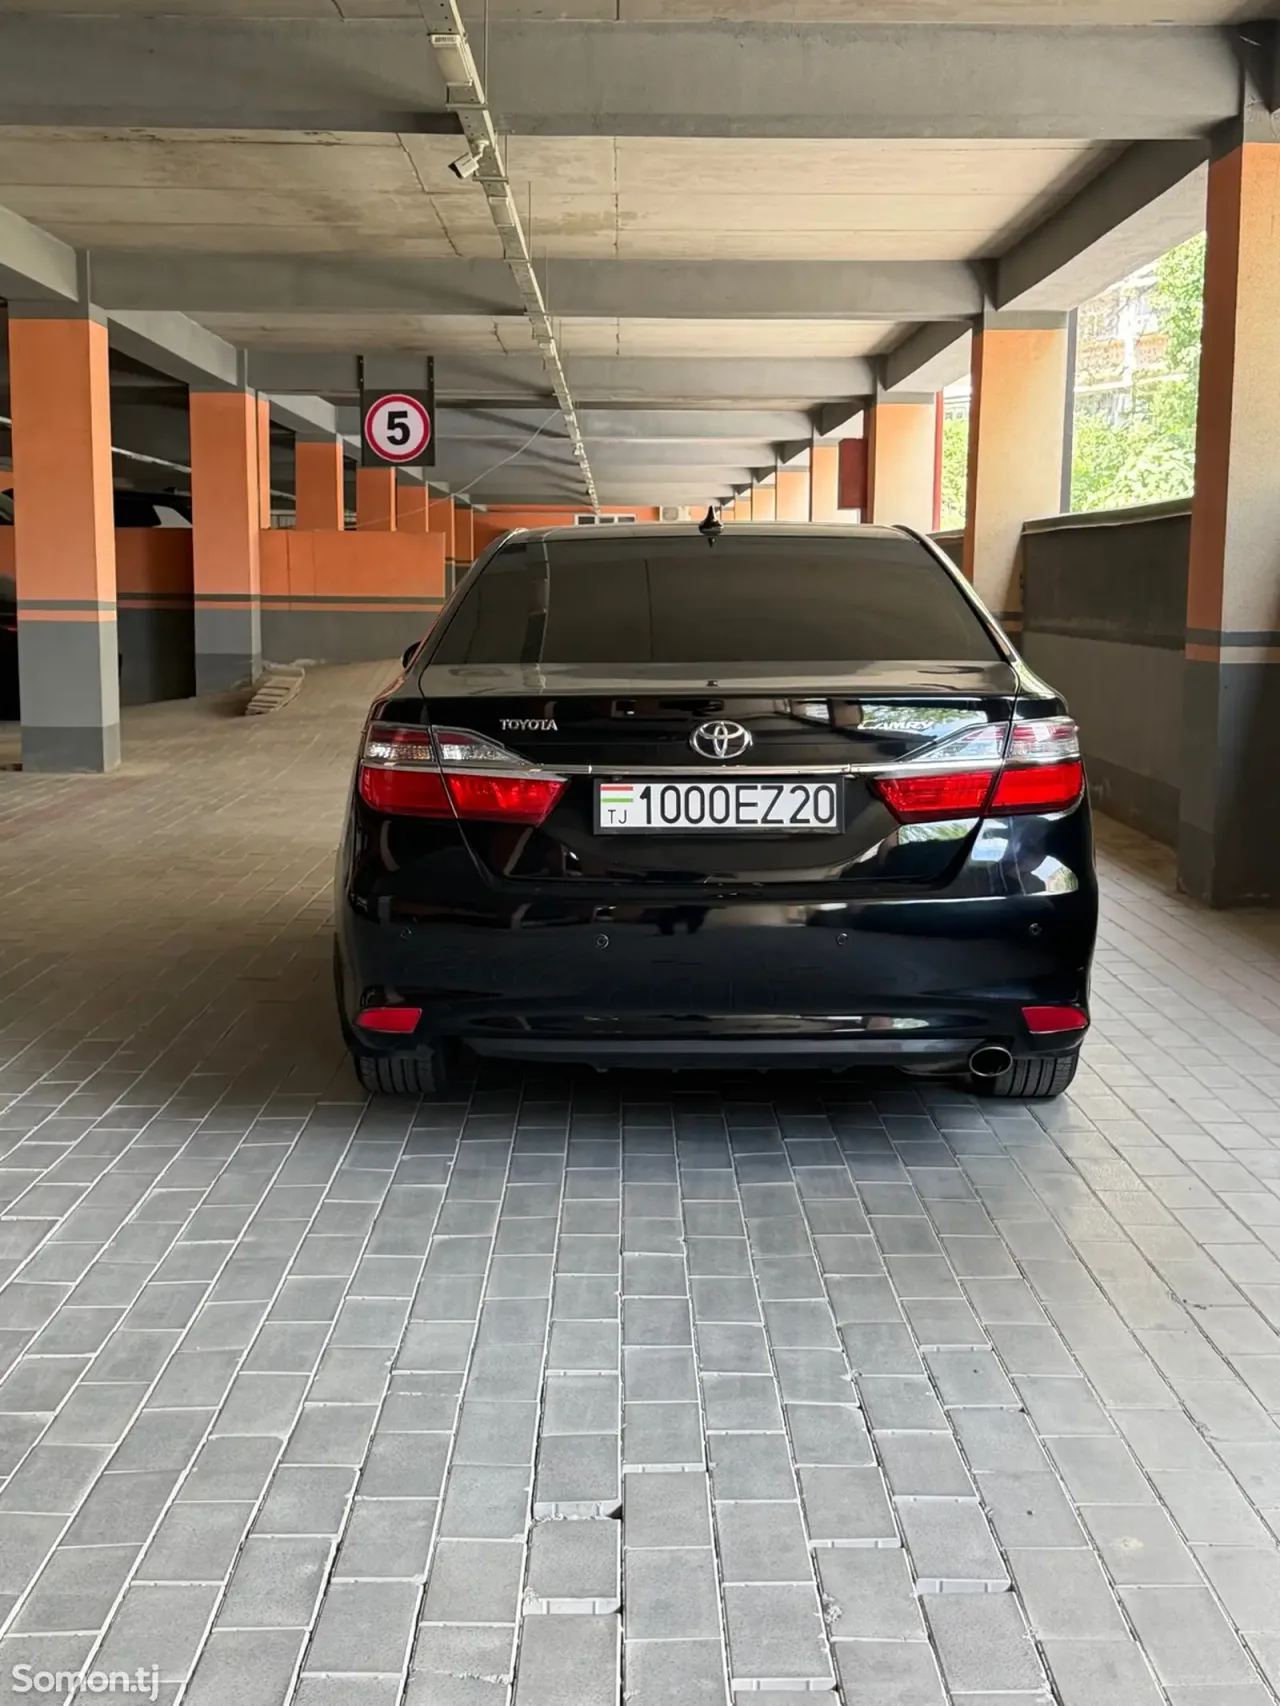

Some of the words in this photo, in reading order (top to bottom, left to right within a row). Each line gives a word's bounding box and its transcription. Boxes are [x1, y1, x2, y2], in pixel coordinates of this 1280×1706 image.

[386, 410, 411, 446] 5
[499, 718, 558, 731] TOYOTA
[857, 719, 934, 730] CAMRY
[639, 785, 835, 825] 1000EZ20
[607, 809, 628, 825] TJ
